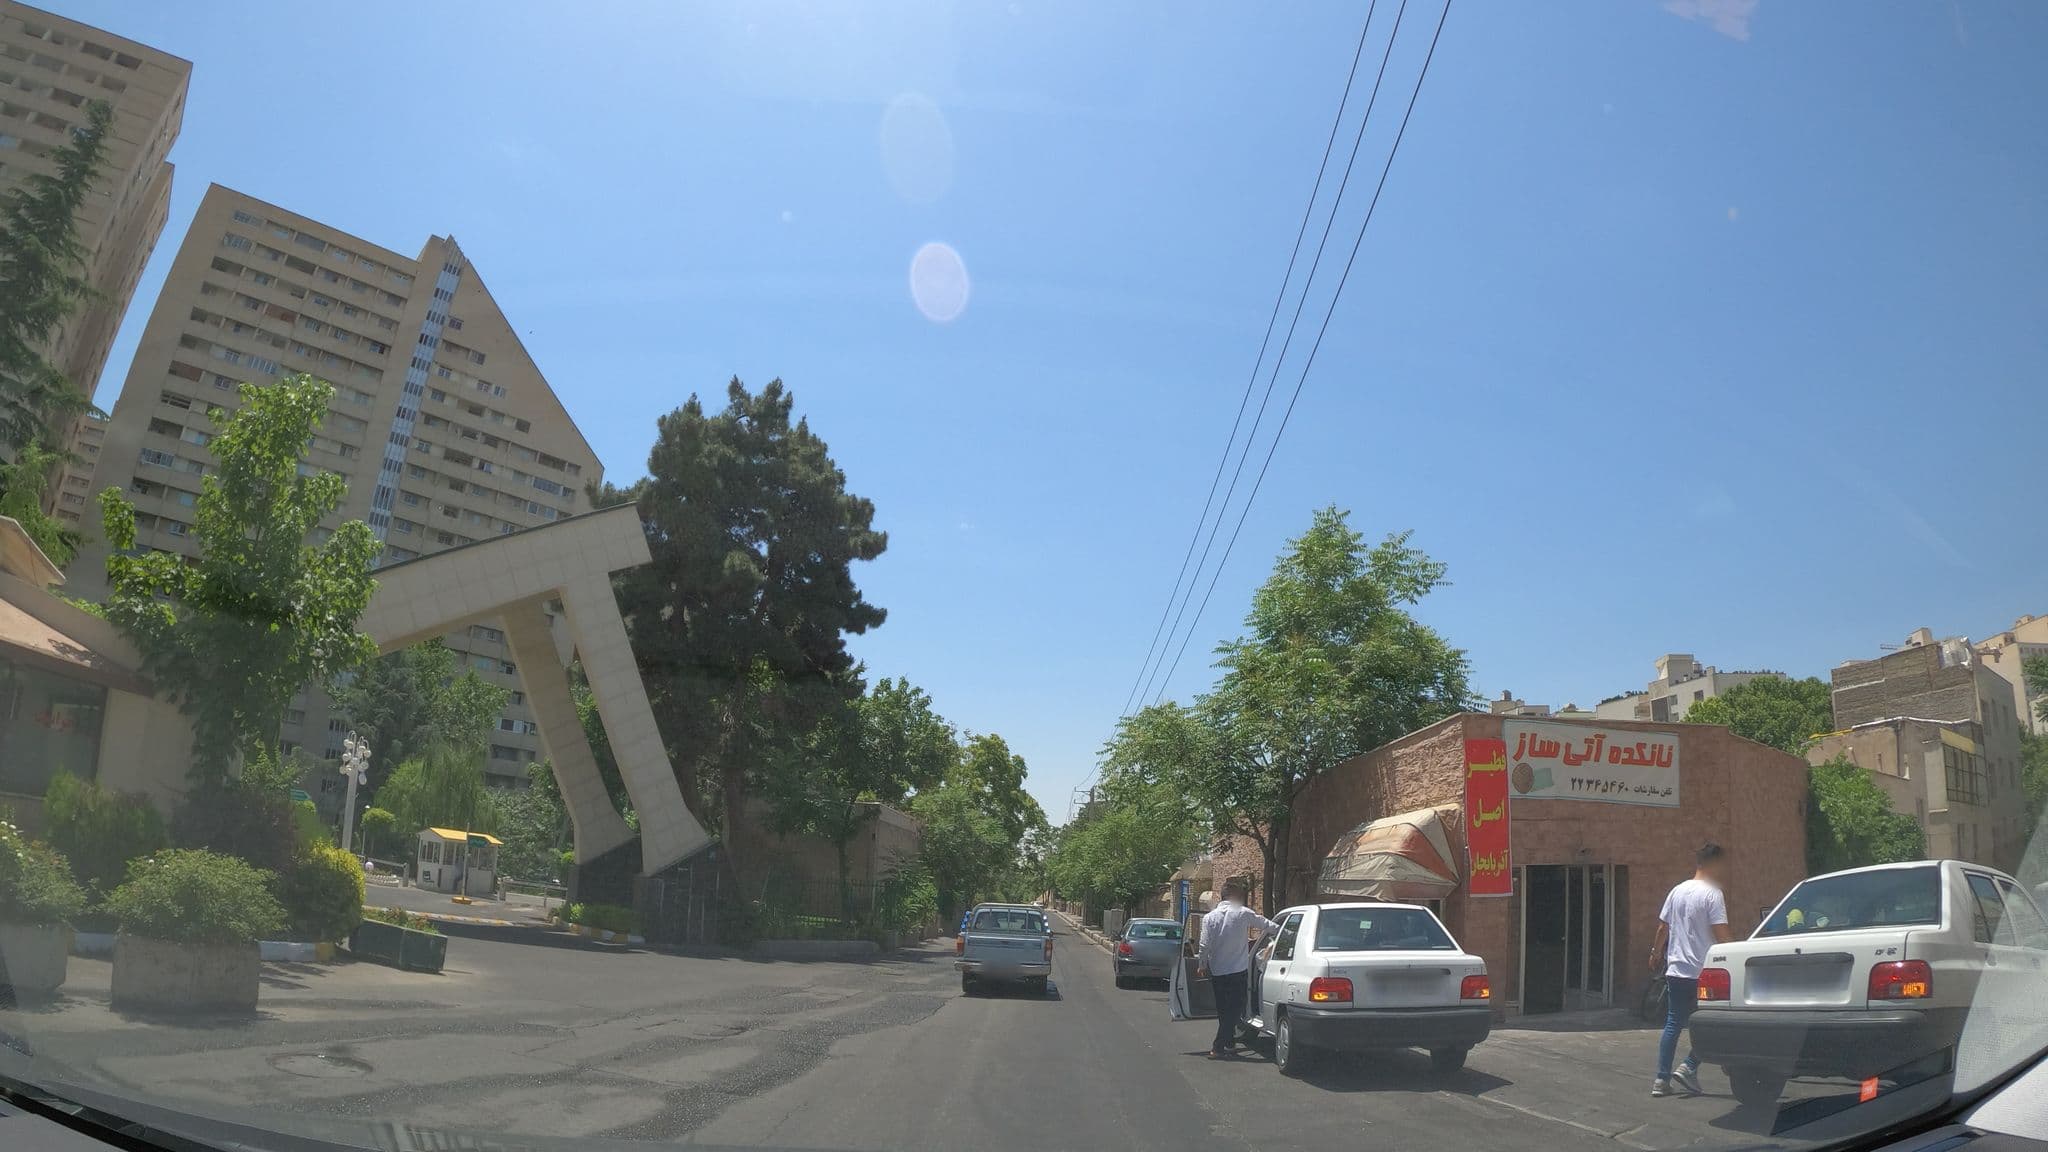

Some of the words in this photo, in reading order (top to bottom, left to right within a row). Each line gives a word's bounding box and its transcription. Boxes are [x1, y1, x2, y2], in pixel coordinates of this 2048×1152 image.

[1512, 732, 1561, 762] ساز
[1563, 733, 1607, 766] آتی
[1608, 742, 1674, 768] نانکده
[1473, 798, 1505, 828] اصل
